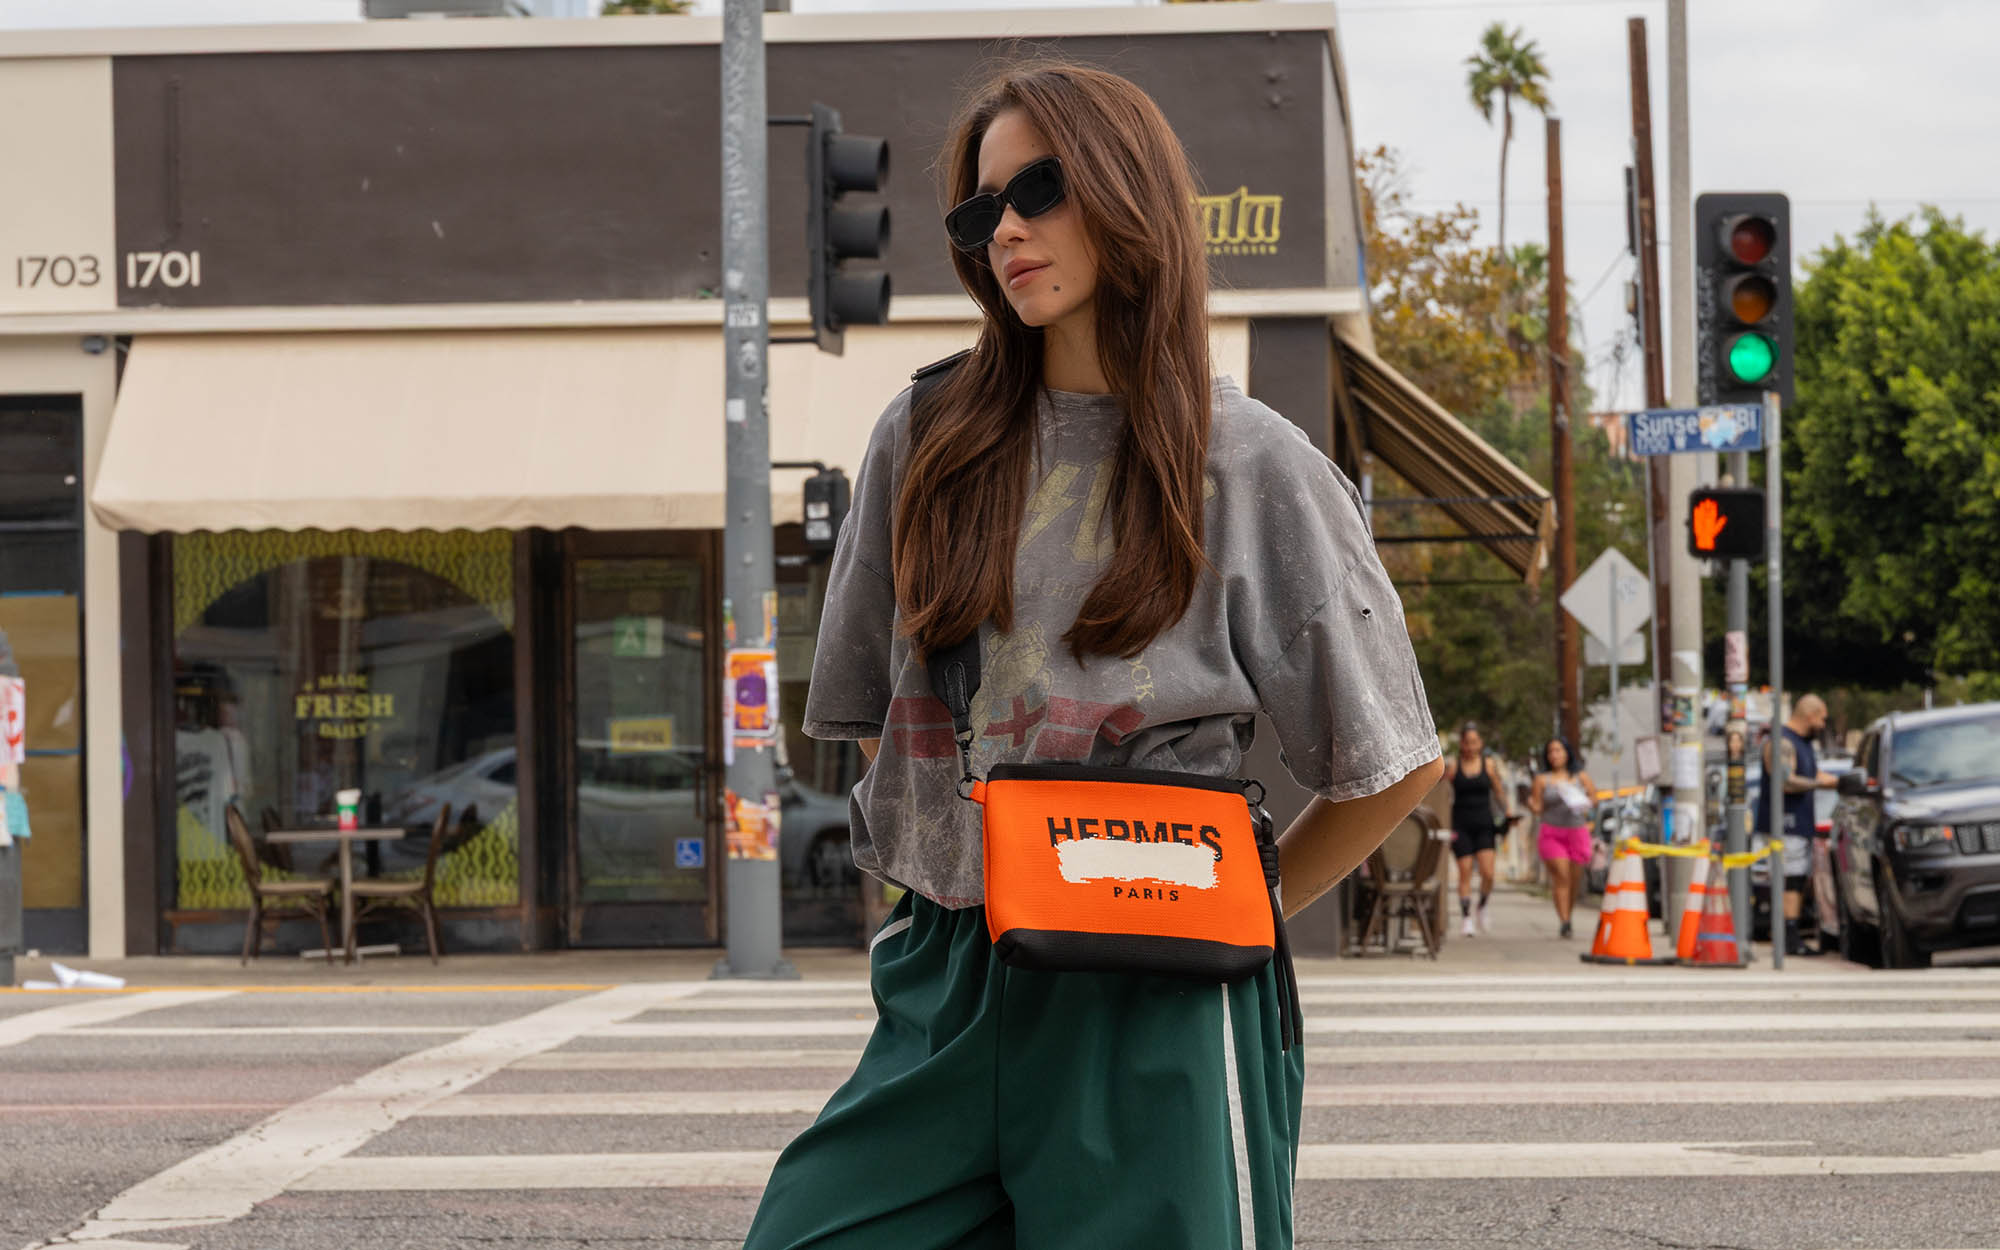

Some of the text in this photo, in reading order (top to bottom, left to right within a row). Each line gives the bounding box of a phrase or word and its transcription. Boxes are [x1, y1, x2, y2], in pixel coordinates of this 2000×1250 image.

[17, 254, 100, 288] 1703
[126, 251, 200, 288] 1701
[1635, 413, 1698, 438] Sunse
[620, 623, 641, 649] A
[319, 673, 366, 689] MADE
[295, 693, 394, 719] FRESH
[319, 721, 367, 739] DAILY
[1113, 886, 1179, 901] PARIS
